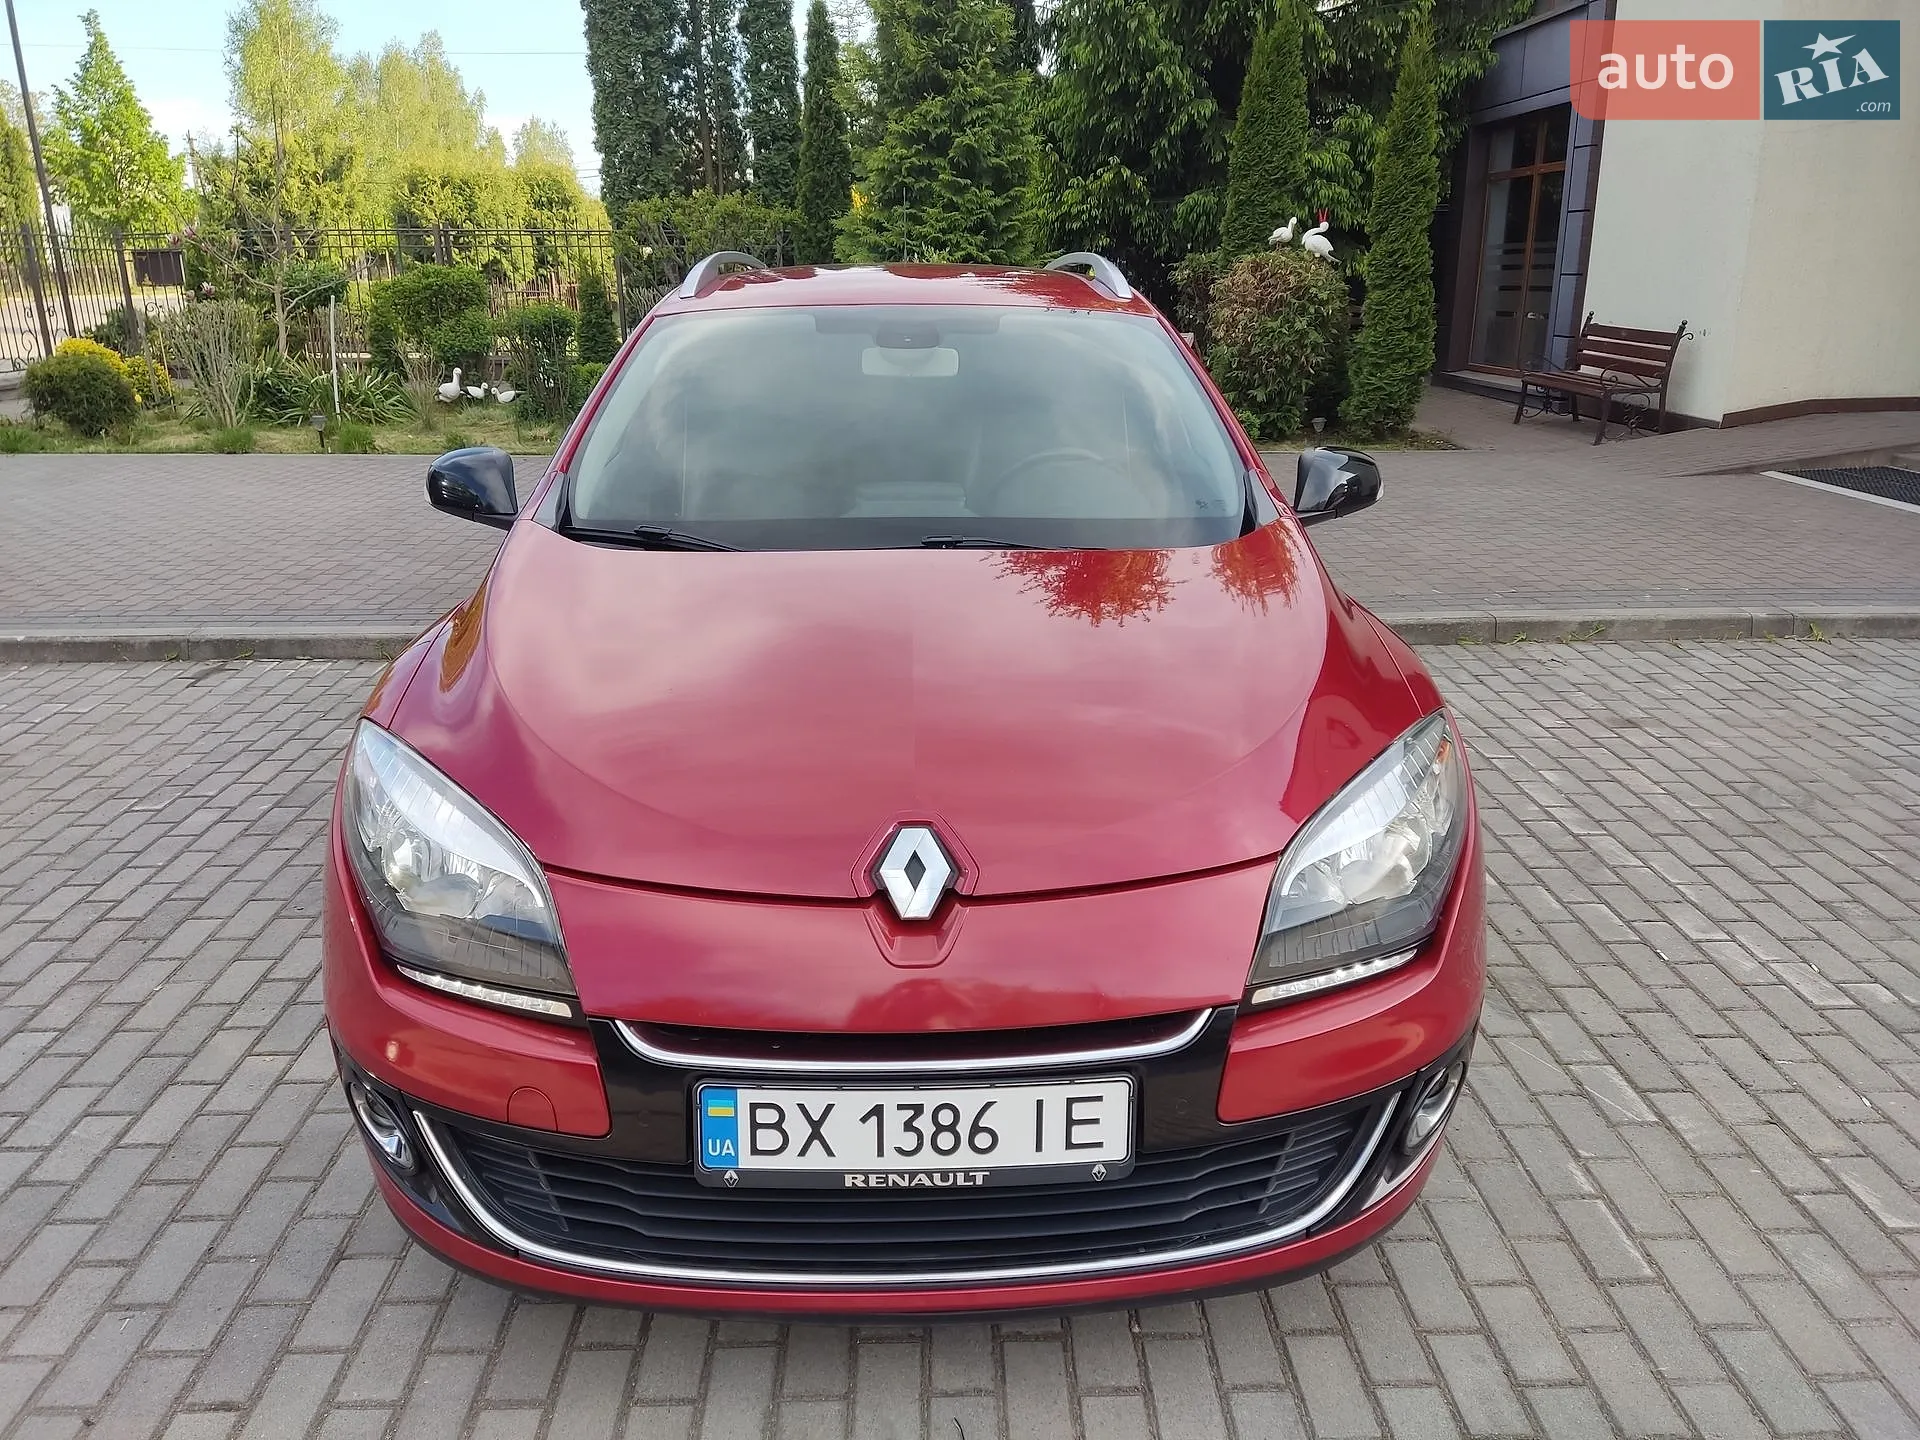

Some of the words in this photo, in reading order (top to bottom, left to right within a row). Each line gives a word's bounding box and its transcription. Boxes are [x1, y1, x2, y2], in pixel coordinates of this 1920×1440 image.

[749, 1102, 836, 1157] BX
[858, 1101, 999, 1157] 1386
[1035, 1095, 1104, 1153] IE
[707, 1139, 735, 1157] UA
[844, 1172, 989, 1187] RENAULT
